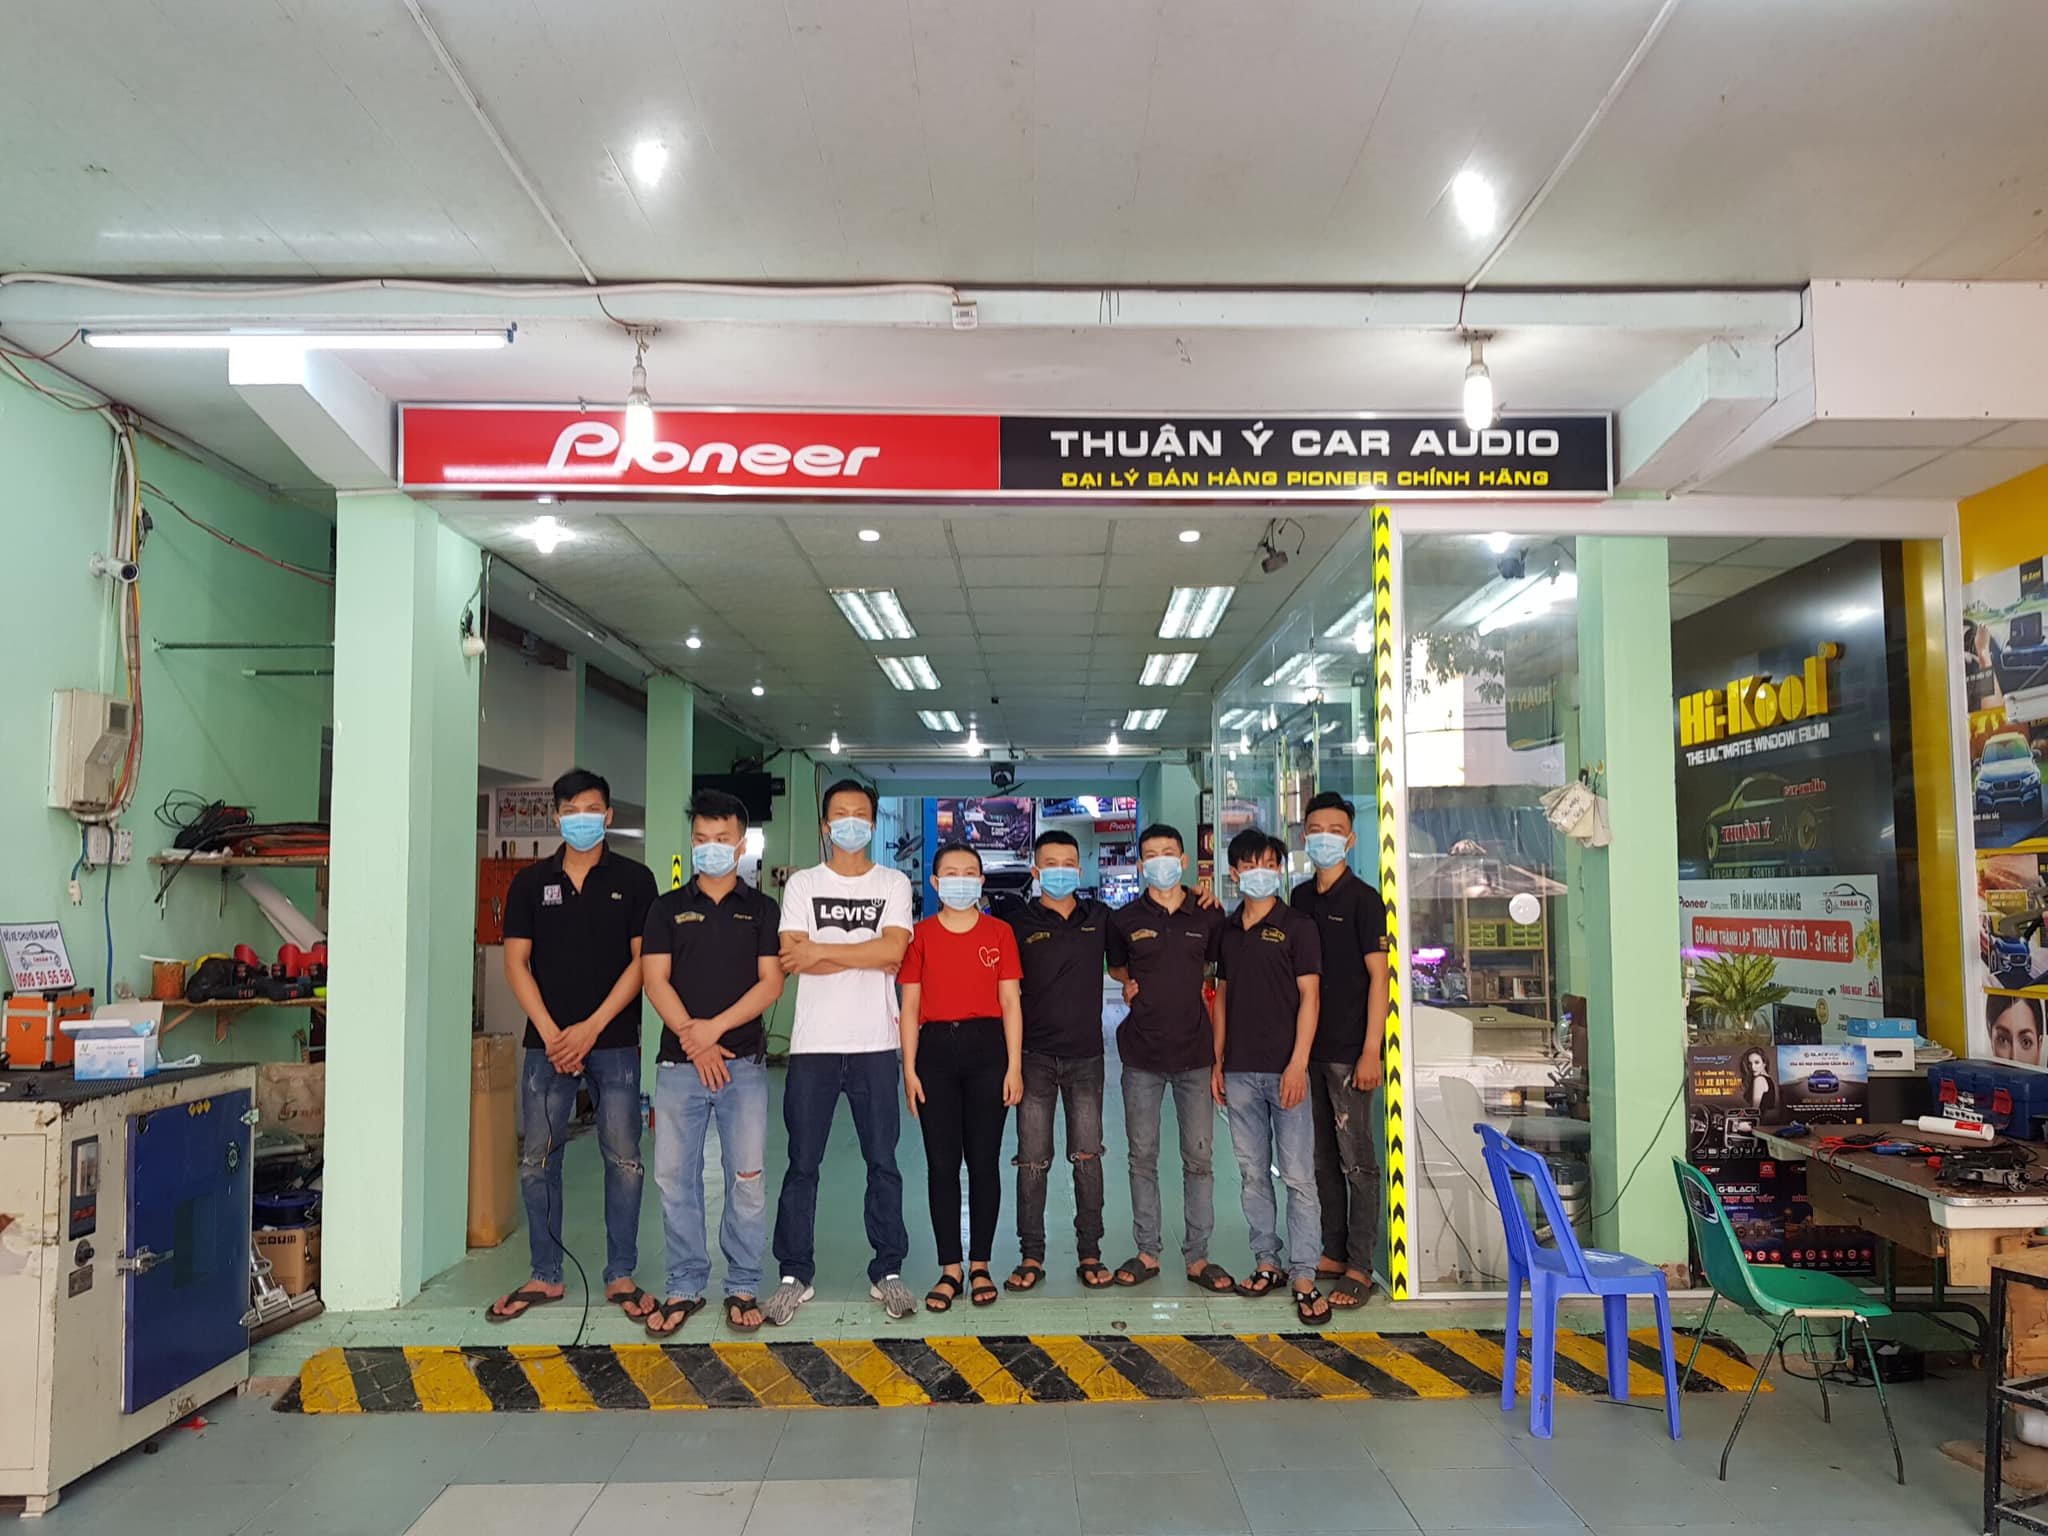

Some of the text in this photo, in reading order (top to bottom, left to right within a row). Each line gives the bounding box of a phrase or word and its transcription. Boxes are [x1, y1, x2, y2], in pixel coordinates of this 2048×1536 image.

[1050, 421, 1559, 463] THUẬN Ý CAR AUDIO
[1110, 468, 1139, 487] LÝ
[1148, 468, 1198, 487] BÁN
[1208, 467, 1278, 487] HÀNG
[1287, 471, 1388, 487] PIONEER
[1397, 467, 1470, 486] CHÍNH
[1479, 468, 1549, 486] HÃNG
[1686, 749, 1705, 767] THE
[1754, 728, 1796, 752] WINDOW
[1721, 819, 1760, 845] THUẬN
[1695, 925, 1704, 944] 60
[1752, 924, 1779, 953] THUẬN
[1790, 925, 1808, 951] ÔTÔ
[1815, 930, 1822, 952] 3
[1822, 931, 1837, 953] THẾ
[1718, 1185, 1758, 1193] G-BLACK
